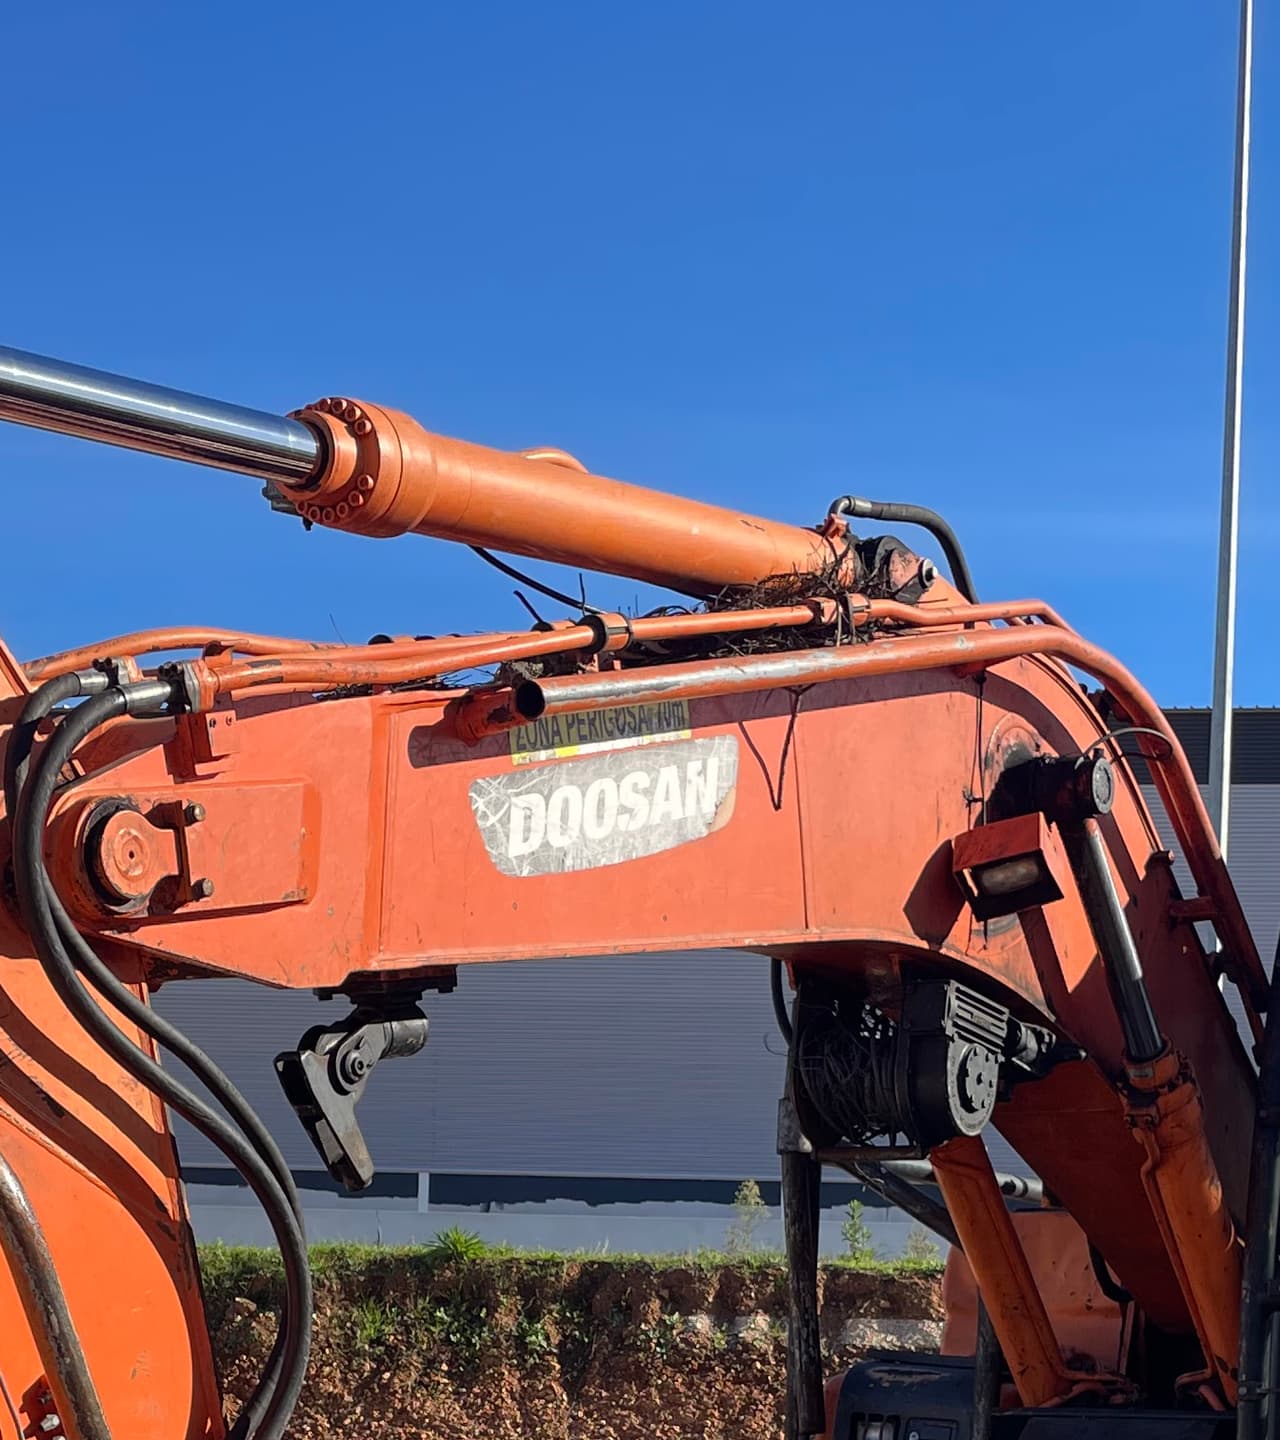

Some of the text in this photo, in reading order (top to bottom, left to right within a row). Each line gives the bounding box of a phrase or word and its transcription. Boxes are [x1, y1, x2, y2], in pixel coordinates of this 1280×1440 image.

[516, 715, 564, 751] ZONA
[565, 704, 651, 745] PERIGOSA
[508, 757, 720, 858] DOOSAN
